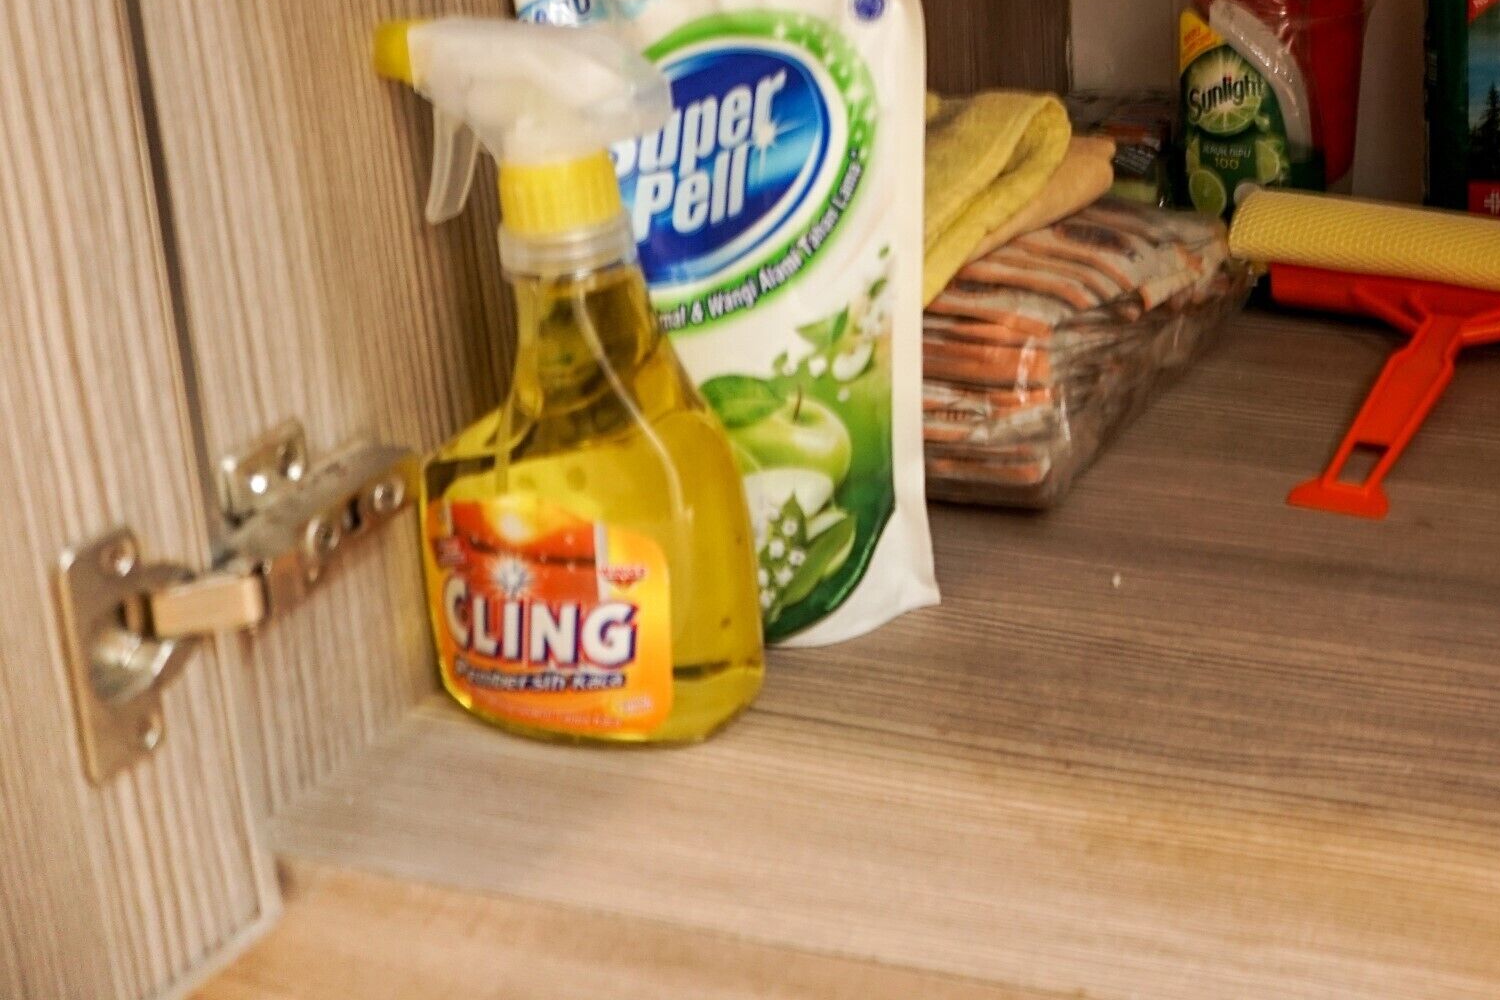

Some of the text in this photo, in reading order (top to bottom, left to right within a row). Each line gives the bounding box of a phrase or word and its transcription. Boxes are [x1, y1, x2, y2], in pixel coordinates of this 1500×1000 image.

[1187, 75, 1263, 122] Sunlight
[632, 141, 748, 244] Pell
[1214, 158, 1240, 170] 100
[707, 278, 757, 319] Wangi
[758, 249, 804, 293] Alami
[443, 574, 639, 669] CLING
